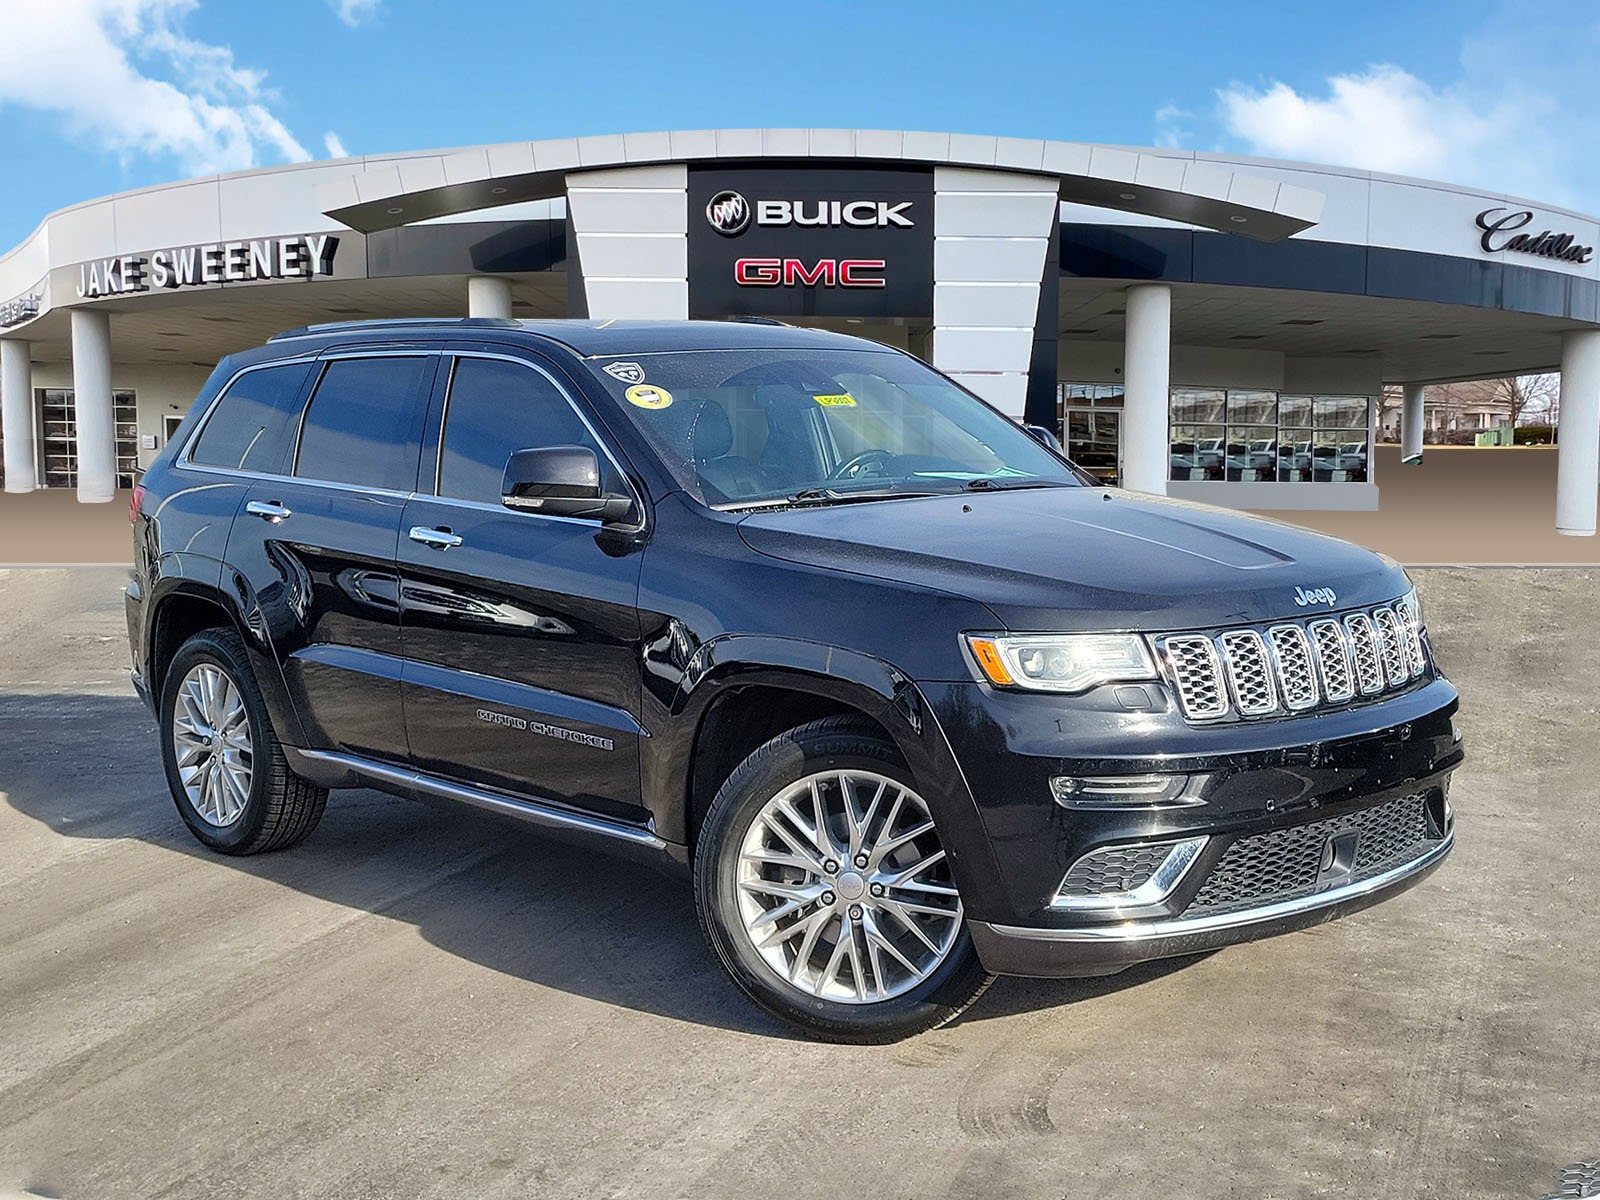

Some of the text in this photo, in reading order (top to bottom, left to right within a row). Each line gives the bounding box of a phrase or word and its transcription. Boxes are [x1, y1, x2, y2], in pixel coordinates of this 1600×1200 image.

[757, 201, 915, 226] BUICK
[1475, 207, 1593, 264] Cadillac
[76, 235, 340, 298] JAKE SWEENEY
[735, 258, 886, 287] GMC
[1293, 585, 1337, 607] Jeep
[476, 708, 614, 751] GRAND CHEROKEE
